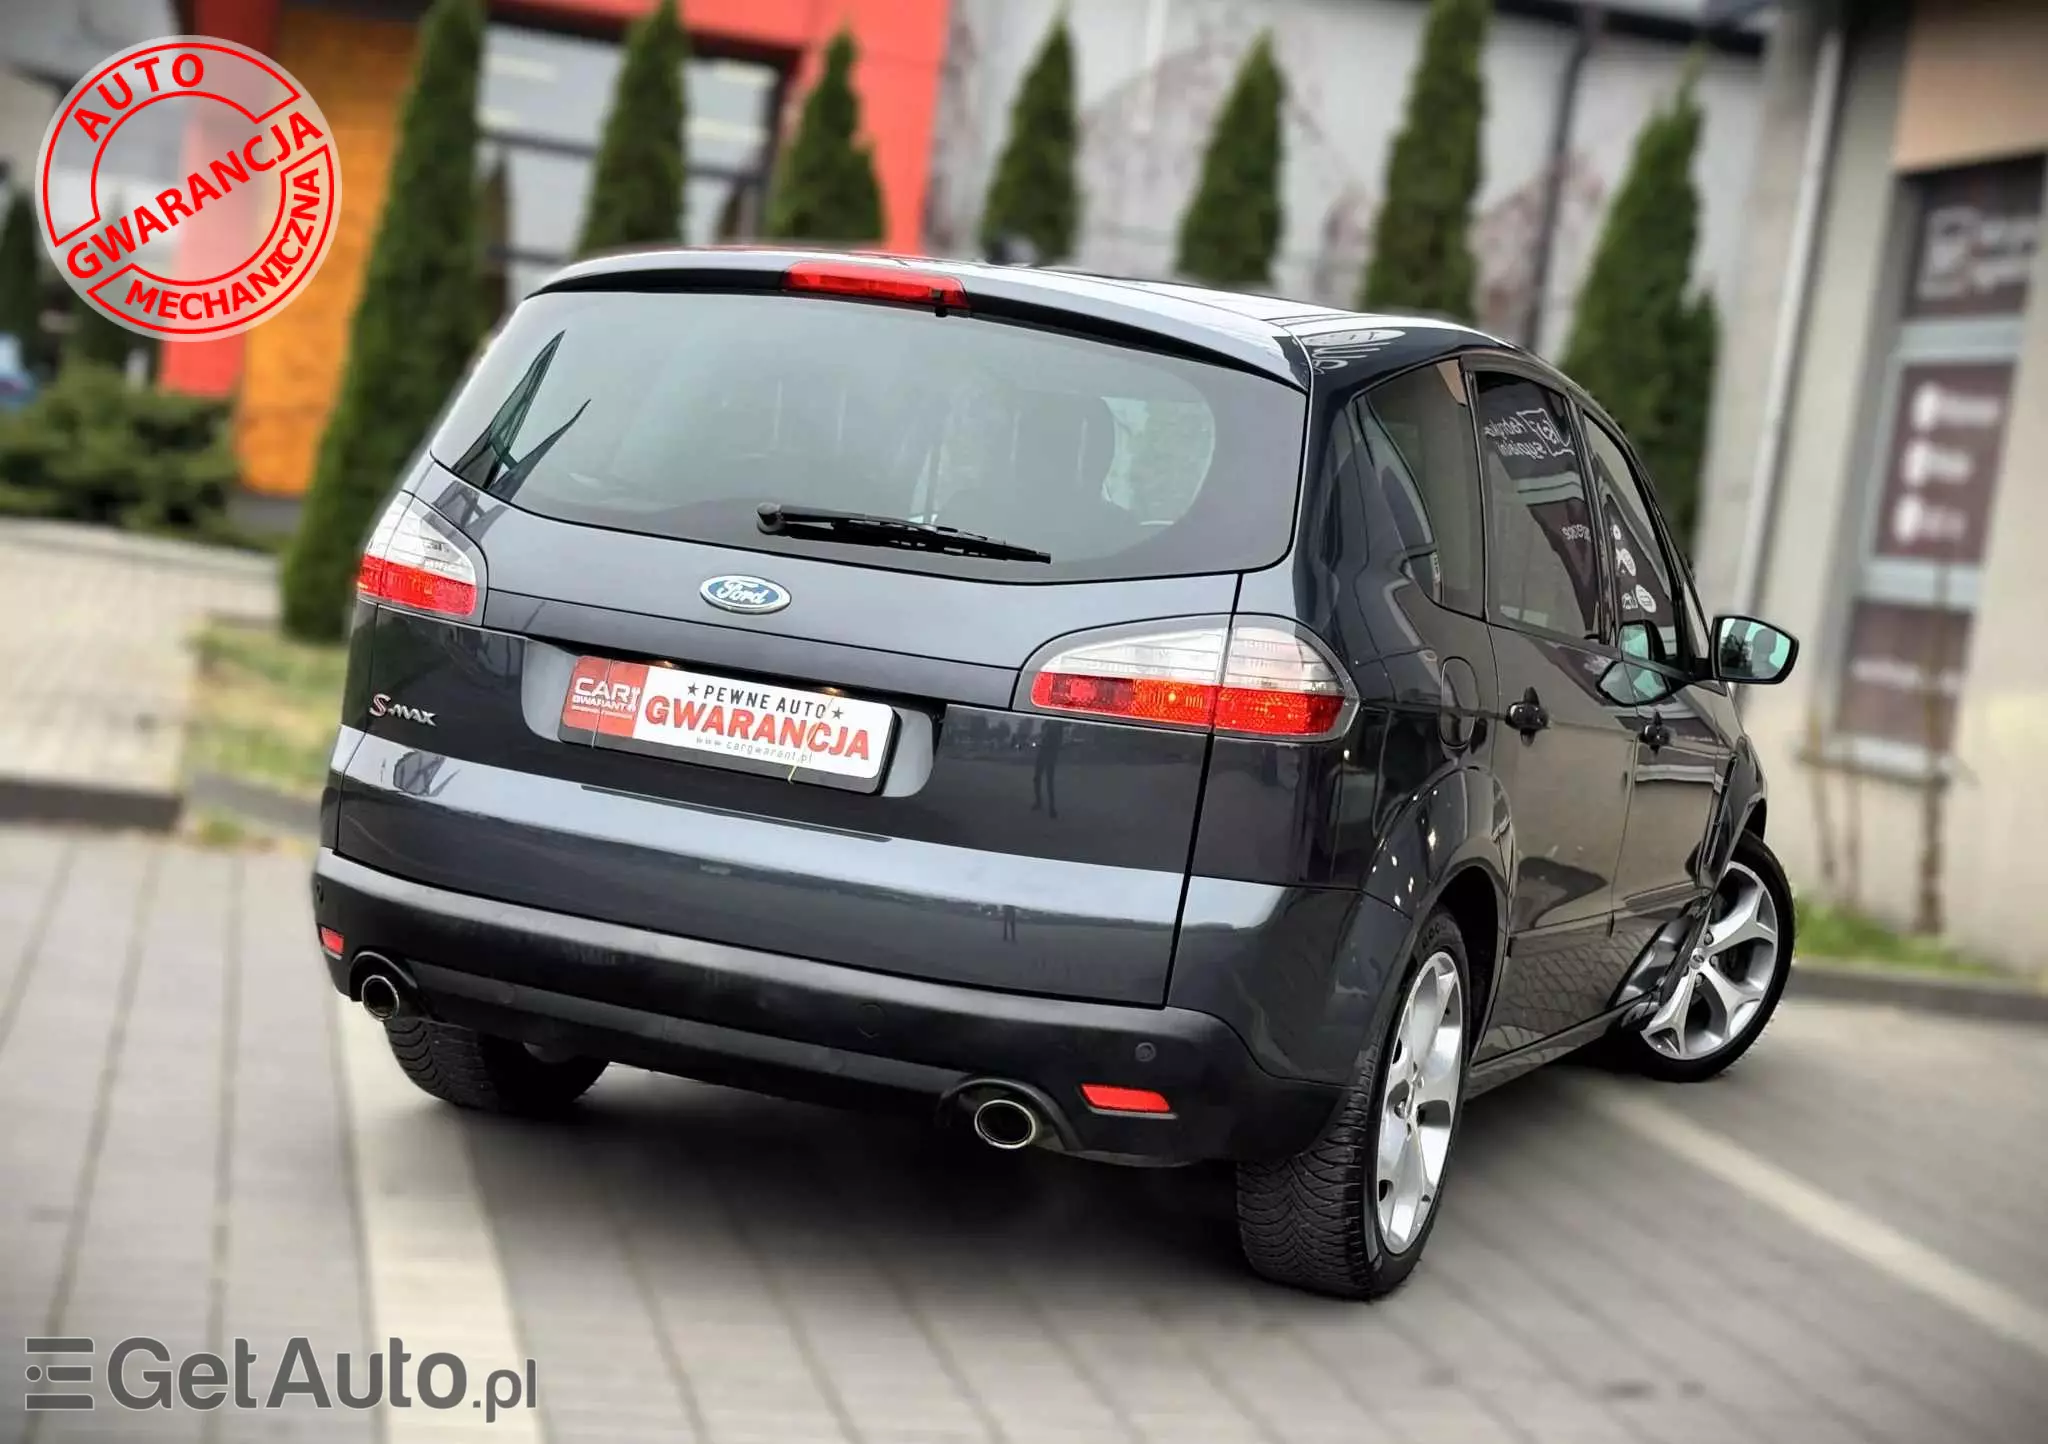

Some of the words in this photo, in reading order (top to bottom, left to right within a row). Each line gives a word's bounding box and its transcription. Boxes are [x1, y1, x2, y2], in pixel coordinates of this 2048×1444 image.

[716, 579, 769, 605] Ford
[703, 685, 771, 710] PEWNE
[775, 697, 827, 719] AUTO
[644, 694, 870, 761] GWARANCJA
[695, 736, 816, 764] wwwcargwarant.pl
